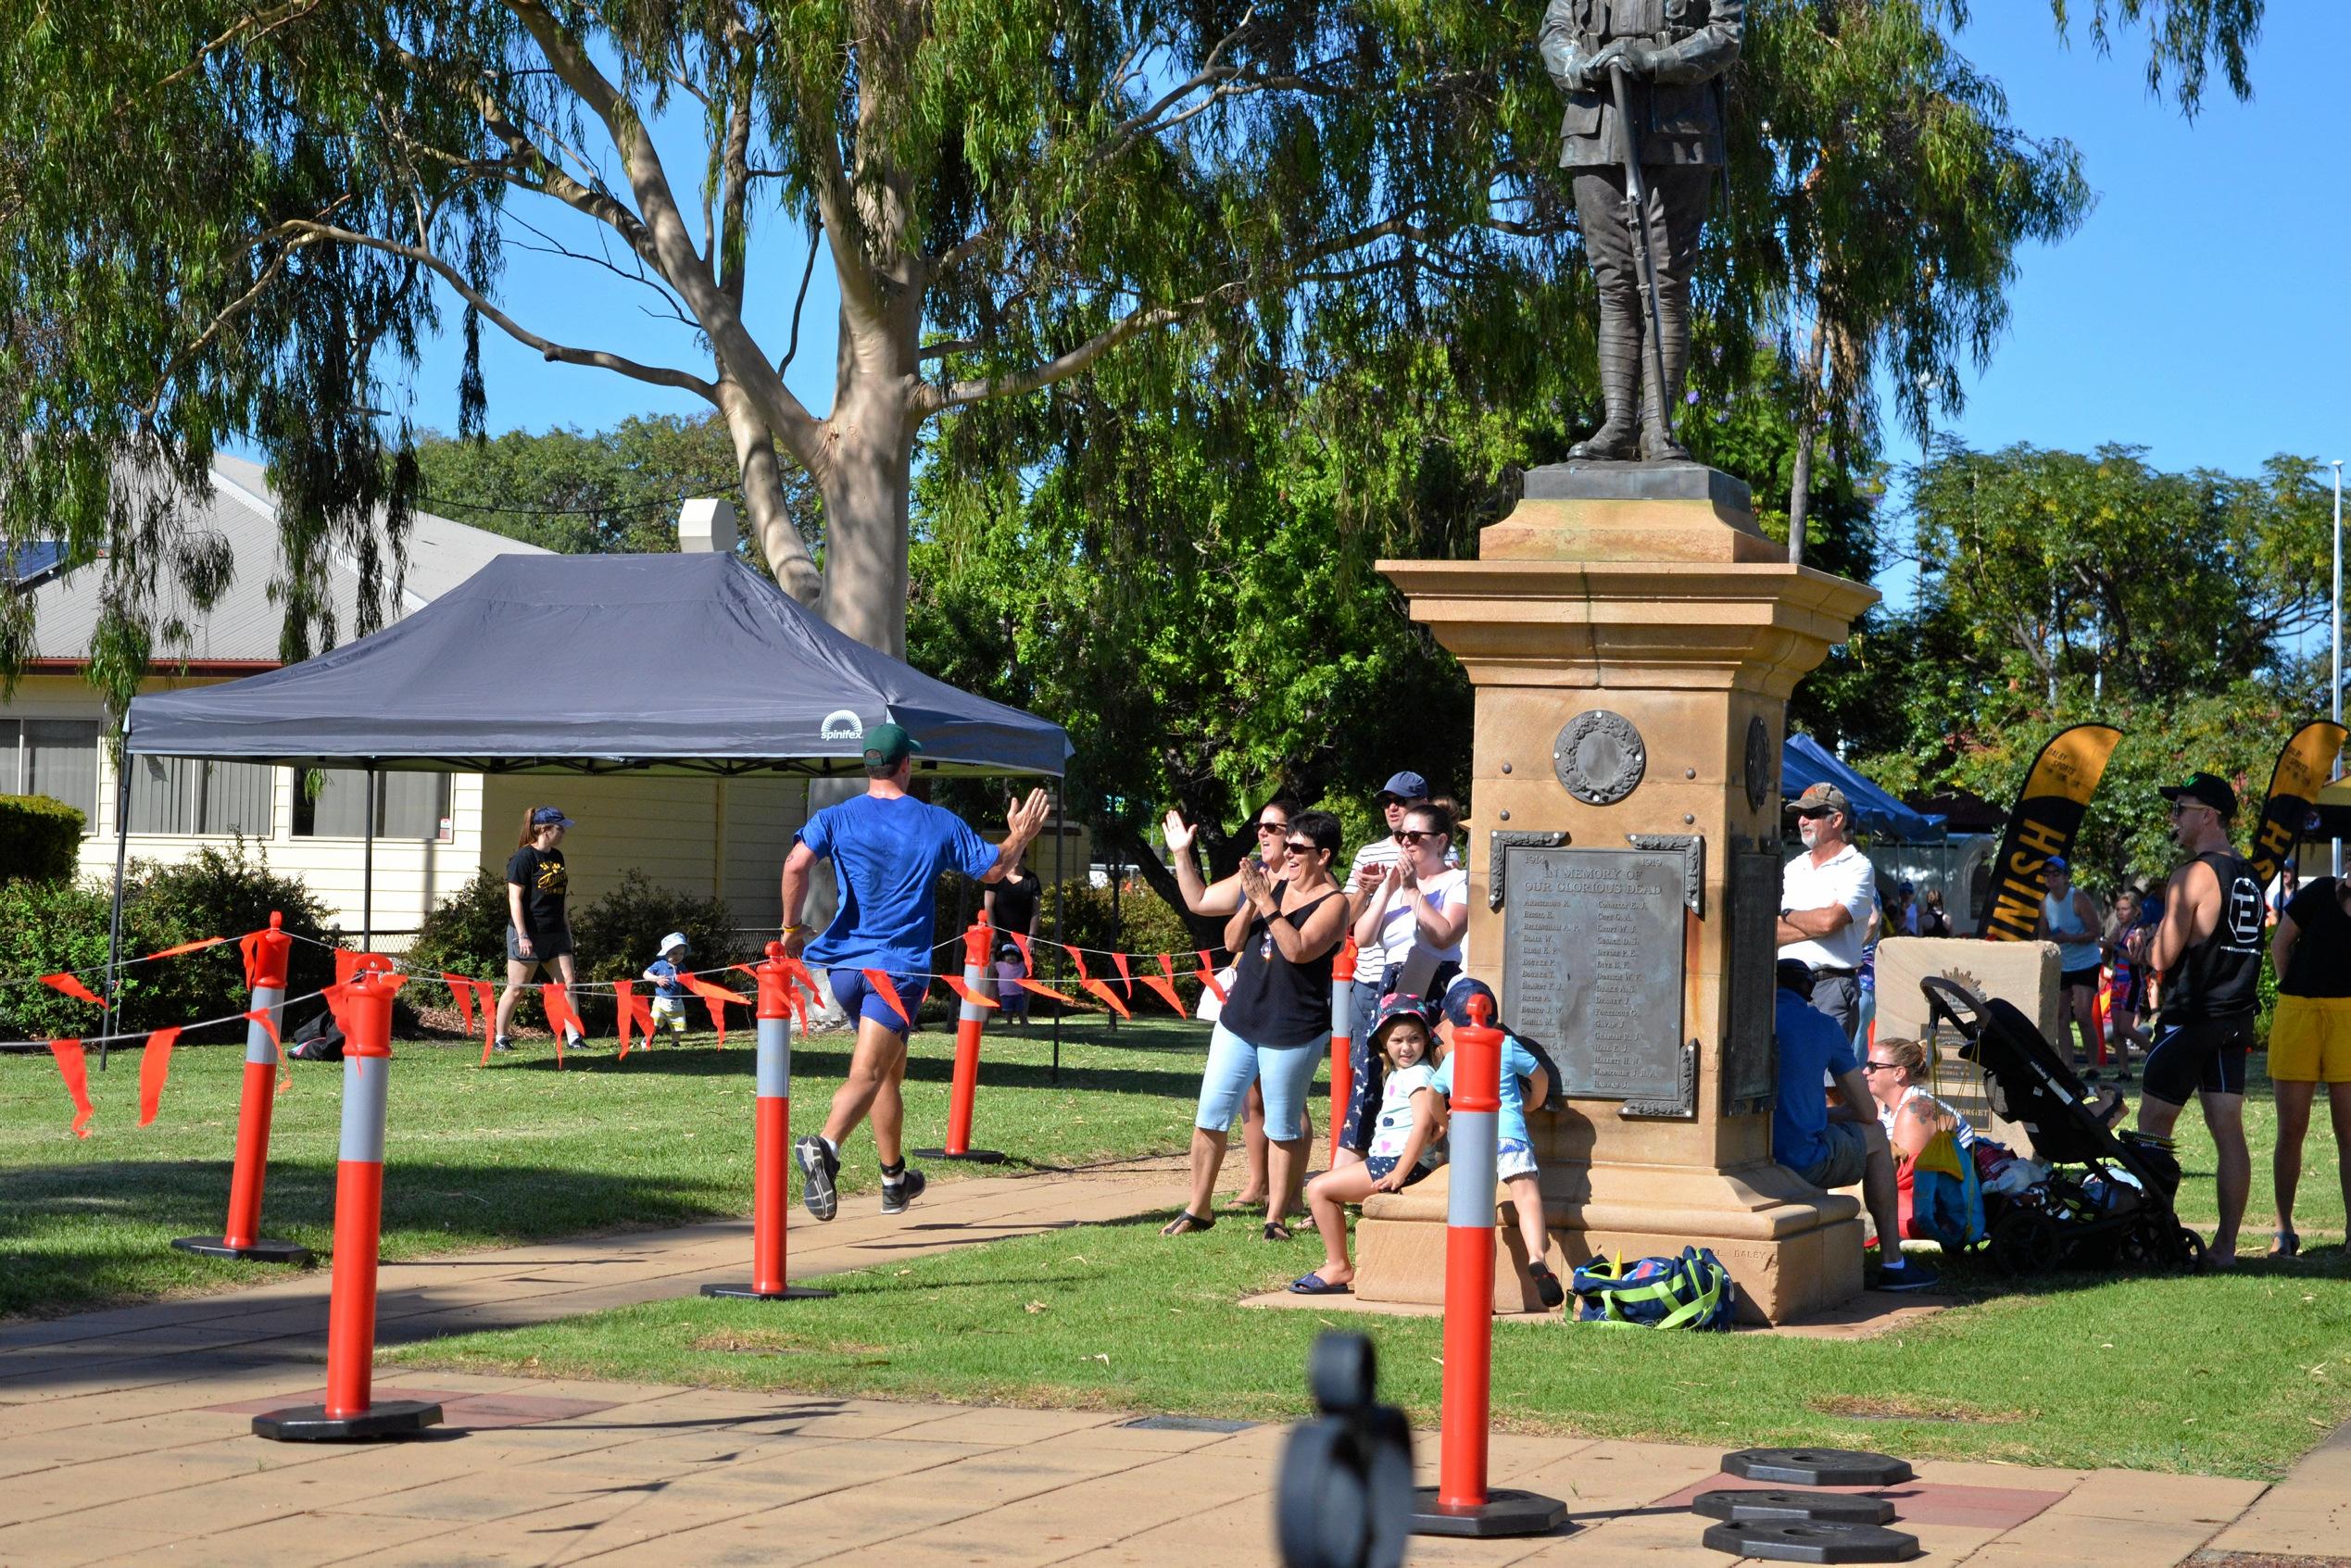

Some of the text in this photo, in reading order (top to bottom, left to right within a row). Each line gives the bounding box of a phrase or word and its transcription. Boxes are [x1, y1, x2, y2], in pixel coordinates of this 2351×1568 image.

[821, 729, 861, 741] spinifex
[2051, 759, 2077, 776] SPORTS
[1641, 859, 1662, 868] 1919
[1543, 868, 1644, 880] IN MEMORY OF
[1525, 882, 1663, 895] OUR GLORIOUS DEAD
